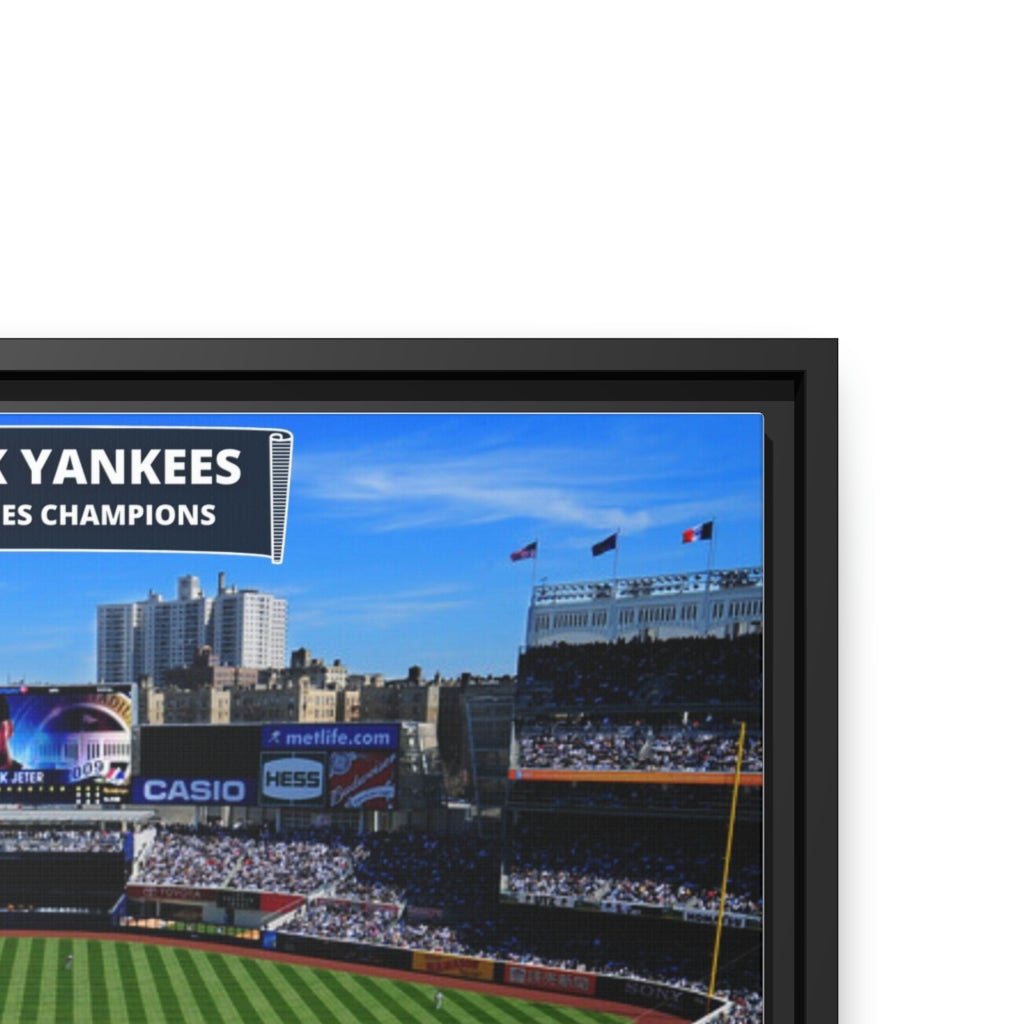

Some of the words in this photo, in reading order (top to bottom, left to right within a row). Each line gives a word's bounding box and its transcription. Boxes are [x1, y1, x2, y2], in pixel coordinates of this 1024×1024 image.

[286, 727, 391, 745] metlife.com
[12, 771, 45, 784] JETER
[266, 771, 320, 788] HESS
[144, 780, 246, 802] CASIO
